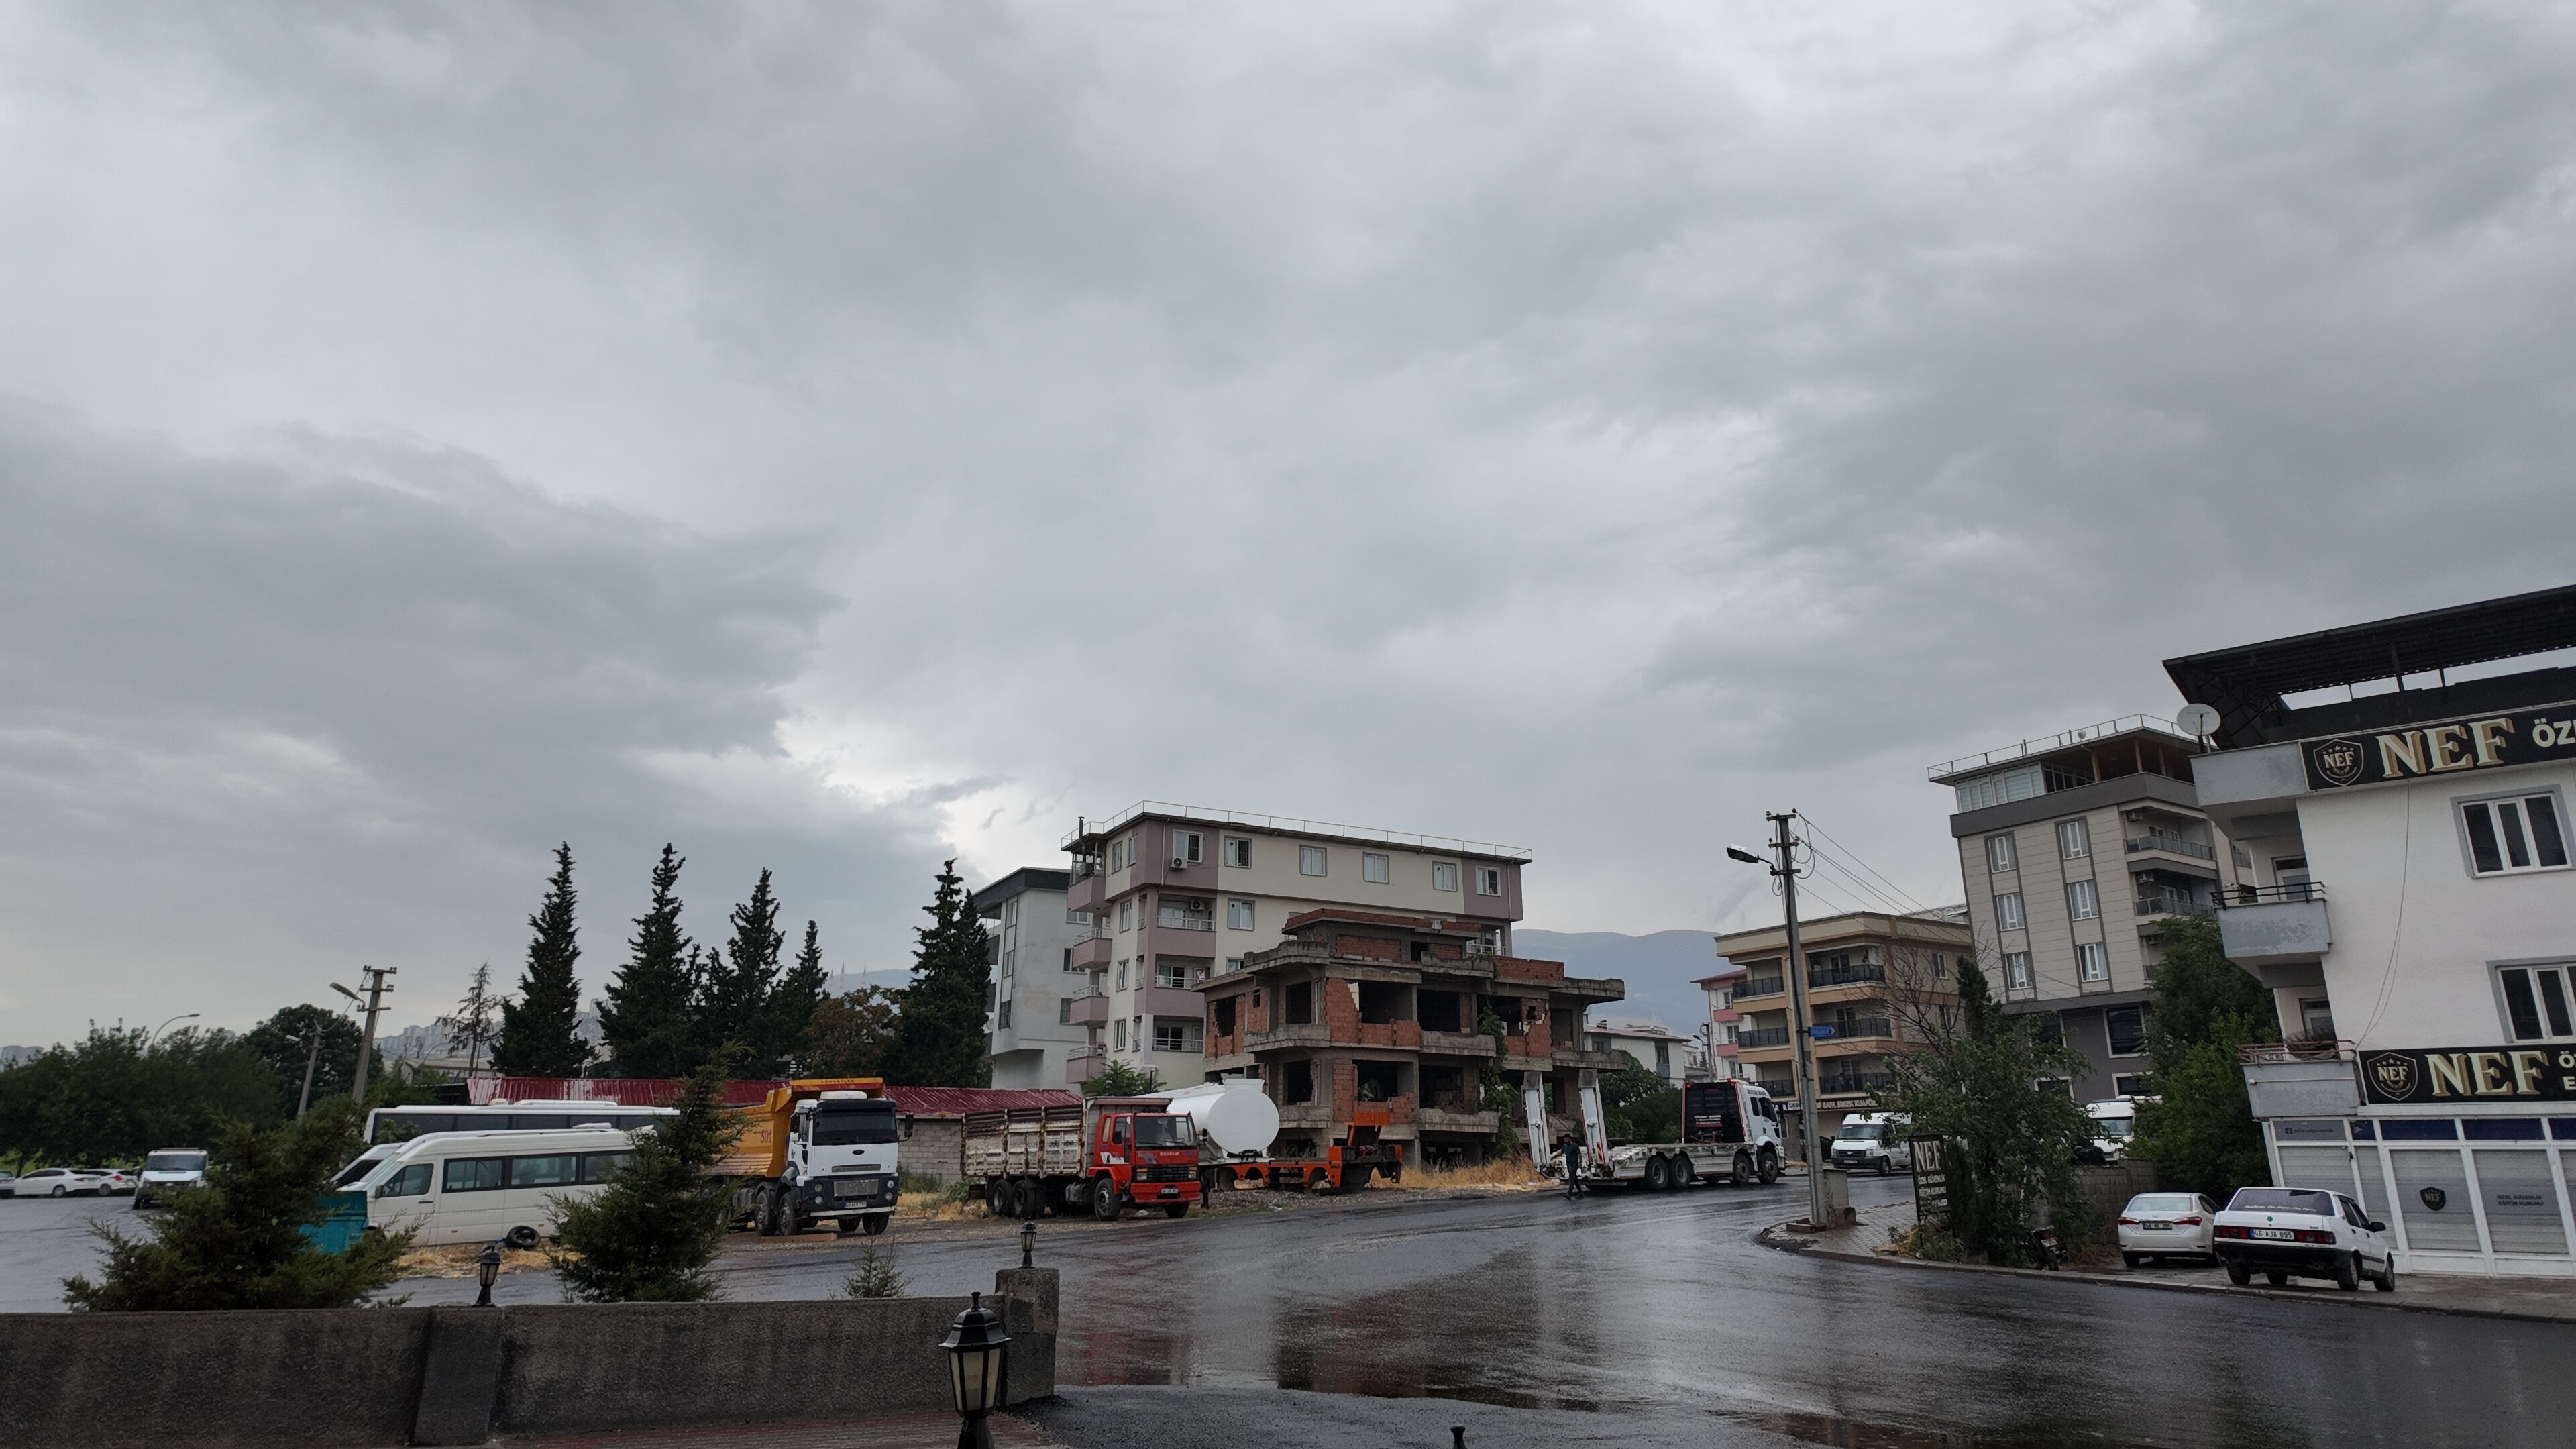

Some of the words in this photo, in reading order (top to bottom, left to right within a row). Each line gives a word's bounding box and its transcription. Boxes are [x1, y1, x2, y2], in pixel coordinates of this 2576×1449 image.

[2323, 750, 2355, 769] NEF
[2375, 718, 2515, 778] NEF
[2532, 718, 2576, 747] ÖZ
[2377, 1066, 2409, 1081] NEF
[2424, 1051, 2549, 1097] NEF
[1913, 1140, 1942, 1172] NEF
[2424, 1193, 2442, 1201] NEF
